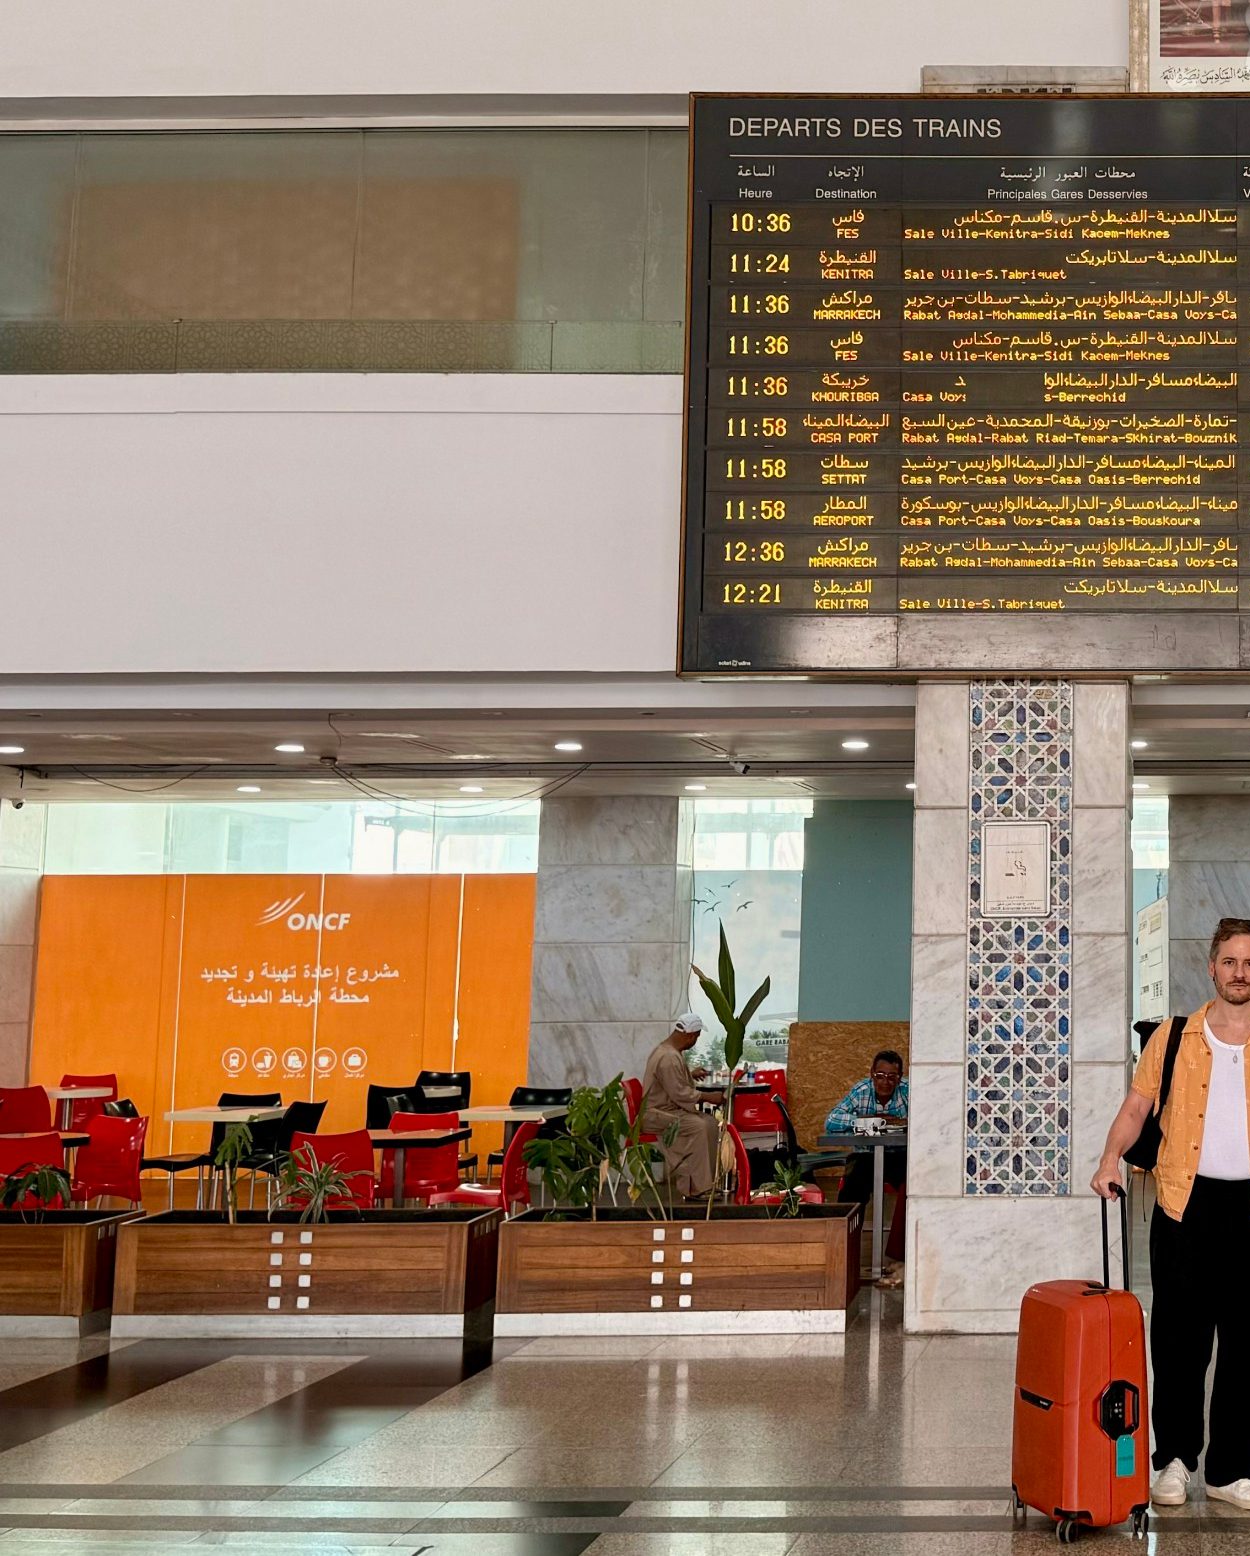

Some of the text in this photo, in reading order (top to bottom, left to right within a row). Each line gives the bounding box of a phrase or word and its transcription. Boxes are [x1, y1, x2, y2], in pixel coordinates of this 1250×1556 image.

[729, 117, 1002, 138] DEPARTS DES TRAINS
[737, 164, 775, 177] الساعة
[1000, 166, 1136, 182] محطات العبور الرئيسية
[739, 187, 773, 199] Heure
[815, 188, 877, 199] Destination
[987, 188, 1148, 202] Principales Gares Desservies
[731, 212, 791, 233] 10:36
[832, 209, 865, 227] فاس
[836, 228, 860, 239] FES
[904, 228, 935, 239] Sale
[730, 253, 790, 273] 11:24
[818, 249, 877, 267] القنيطرة
[821, 268, 874, 280] KENITRA
[903, 269, 935, 280] Sale
[730, 294, 790, 314] 11:36
[822, 290, 873, 309] مراكش
[813, 309, 881, 321] MARRAKECH
[903, 309, 942, 321] Rabat
[729, 335, 789, 355] 11:36
[830, 330, 864, 349] فاس
[834, 350, 858, 361] FES
[902, 350, 934, 362] Sale
[727, 376, 788, 396] 11:36
[821, 372, 870, 390] خريبكة
[811, 391, 880, 402] KHOURIBGA
[902, 391, 933, 402] Casa
[727, 417, 787, 437] 11:58
[810, 432, 879, 443] CASA PORT
[901, 432, 940, 444] Rabat
[726, 458, 787, 478] 11:58
[820, 454, 869, 469] سطات
[821, 473, 868, 485] SETTAT
[901, 473, 932, 485] Casa
[725, 500, 786, 520] 11:58
[822, 495, 867, 514] المطار
[813, 515, 875, 526] AEROPORT
[900, 515, 932, 526] Casa
[724, 541, 785, 562] 12:36
[817, 537, 869, 556] مراكش
[808, 556, 878, 568] MARRAKECH
[899, 556, 939, 568] Rabat
[723, 583, 781, 603] 12:21
[813, 578, 872, 597] القنيطرة
[815, 598, 869, 610] KENITRA
[899, 598, 931, 610] Sale
[287, 913, 351, 931] ONCF
[200, 965, 237, 983] تجديد
[243, 968, 255, 983] و
[304, 964, 340, 983] إعادة
[346, 963, 400, 985] مشروع
[226, 986, 370, 1008] محطة الرباط المدينة
